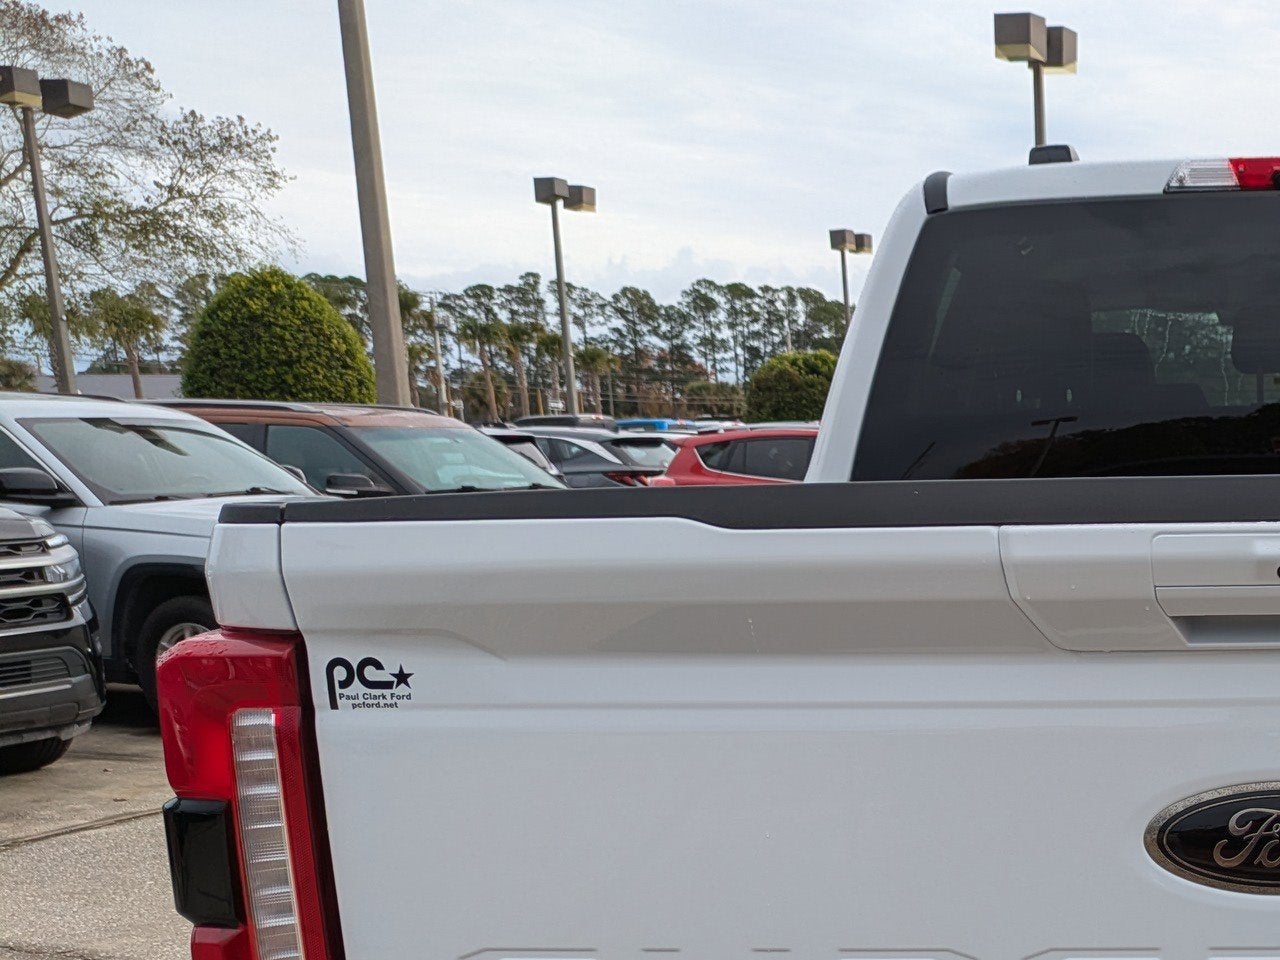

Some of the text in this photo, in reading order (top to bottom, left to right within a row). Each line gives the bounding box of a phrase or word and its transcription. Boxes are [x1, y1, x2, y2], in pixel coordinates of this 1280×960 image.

[338, 692, 412, 701] Paul Clark Ford
[351, 701, 399, 709] pcford.net
